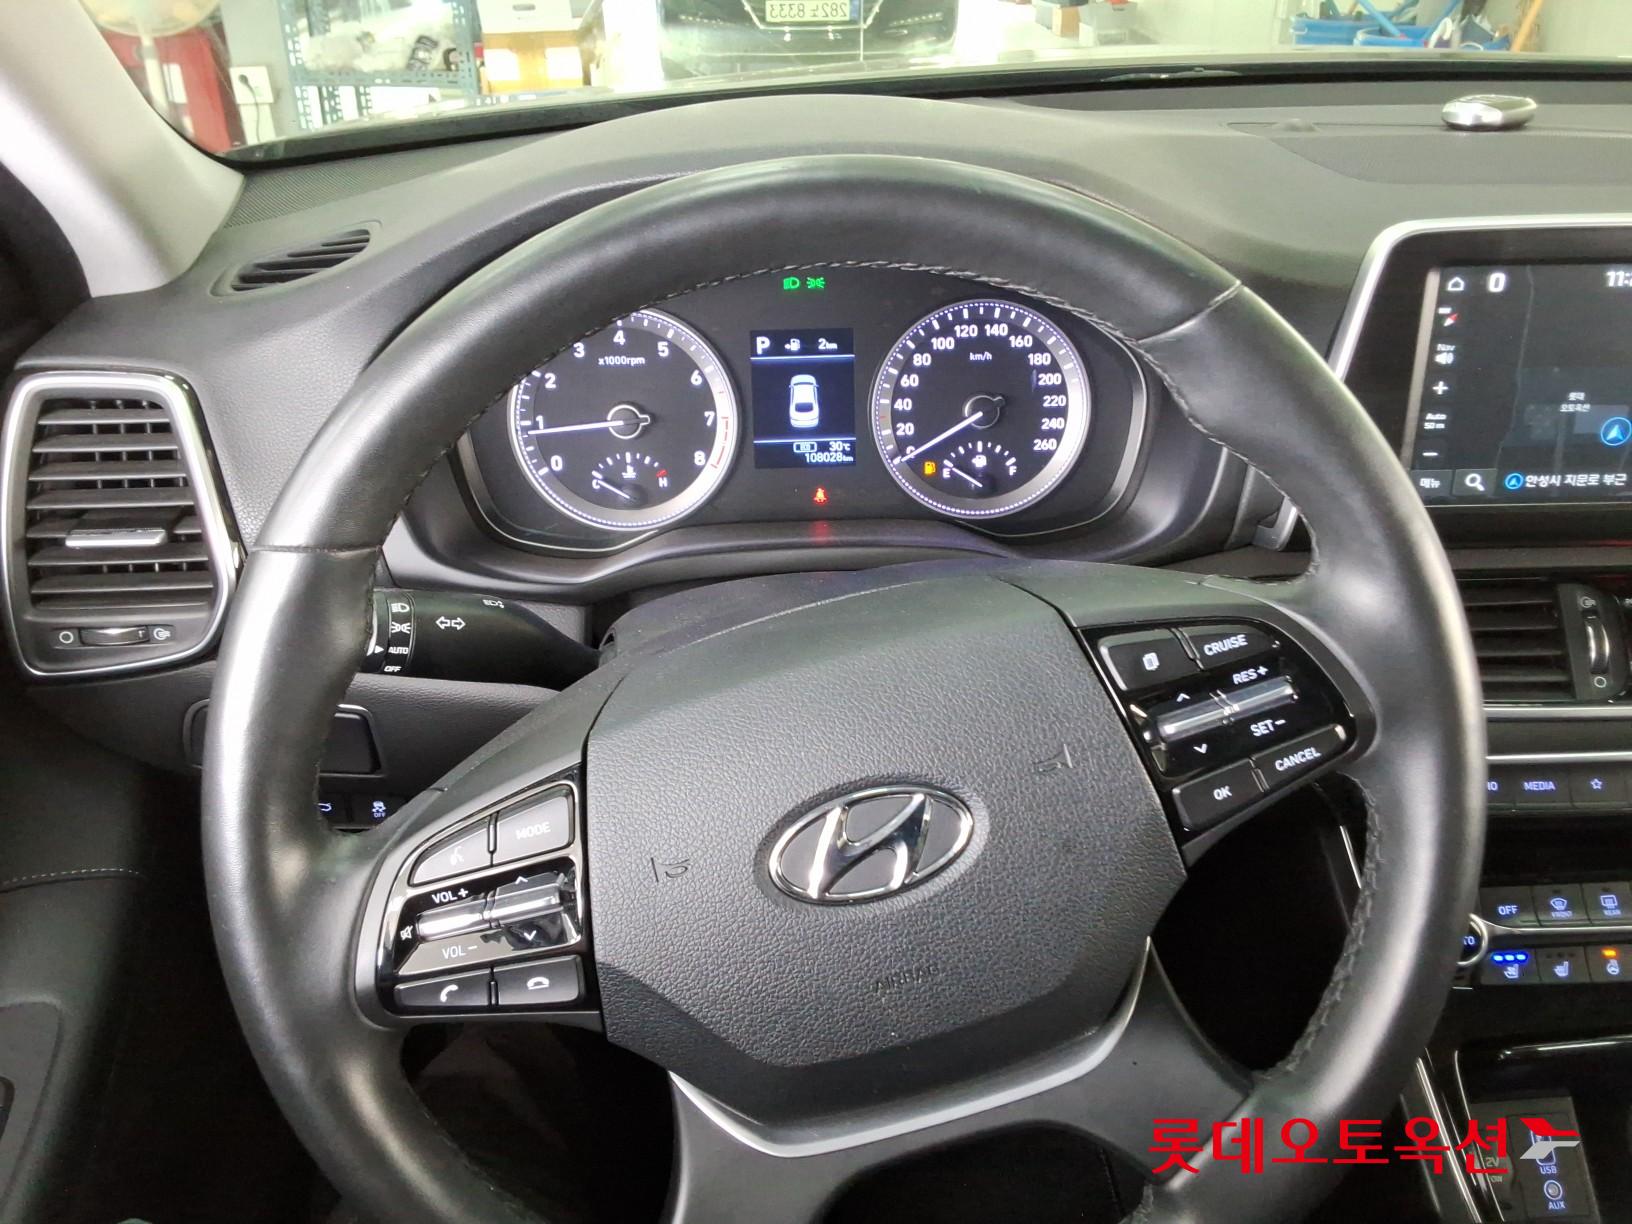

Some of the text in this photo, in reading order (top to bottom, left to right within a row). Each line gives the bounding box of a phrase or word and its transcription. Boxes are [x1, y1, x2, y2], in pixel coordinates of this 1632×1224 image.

[613, 329, 626, 345] 4
[954, 324, 979, 338] 120
[984, 323, 1009, 337] 140
[756, 336, 771, 355] P
[931, 337, 955, 351] 100
[1008, 335, 1033, 348] 160
[573, 342, 585, 358] 3
[657, 342, 669, 357] 5
[969, 351, 993, 361] km/h
[598, 356, 646, 366] x1000rpm
[912, 353, 932, 366] 80
[1028, 353, 1052, 366] 180
[544, 373, 557, 389] 2
[691, 370, 702, 386] 6
[900, 374, 919, 387] 60
[1037, 373, 1062, 386] 200
[893, 398, 912, 412] 40
[1043, 395, 1067, 407] 220
[536, 415, 545, 430] 1
[704, 411, 715, 426] 7
[1041, 417, 1065, 430] 240
[896, 422, 915, 436] 20
[1033, 439, 1057, 451] 260
[550, 455, 564, 471] 0
[693, 450, 706, 466] 8
[942, 468, 951, 478] E
[1009, 466, 1017, 476] F
[658, 478, 668, 488] H
[1525, 475, 1562, 488] 안성시
[1603, 473, 1627, 486] 부근
[388, 646, 409, 655] AUTO
[1203, 634, 1249, 657] CRUISE
[1275, 746, 1322, 772] CANCEL
[1213, 785, 1233, 801] OK
[1523, 781, 1556, 791] MEDIA
[515, 821, 552, 840] MODE
[1498, 905, 1518, 916] OFF
[1539, 1165, 1557, 1175] USB
[1548, 1201, 1566, 1210] AUX
